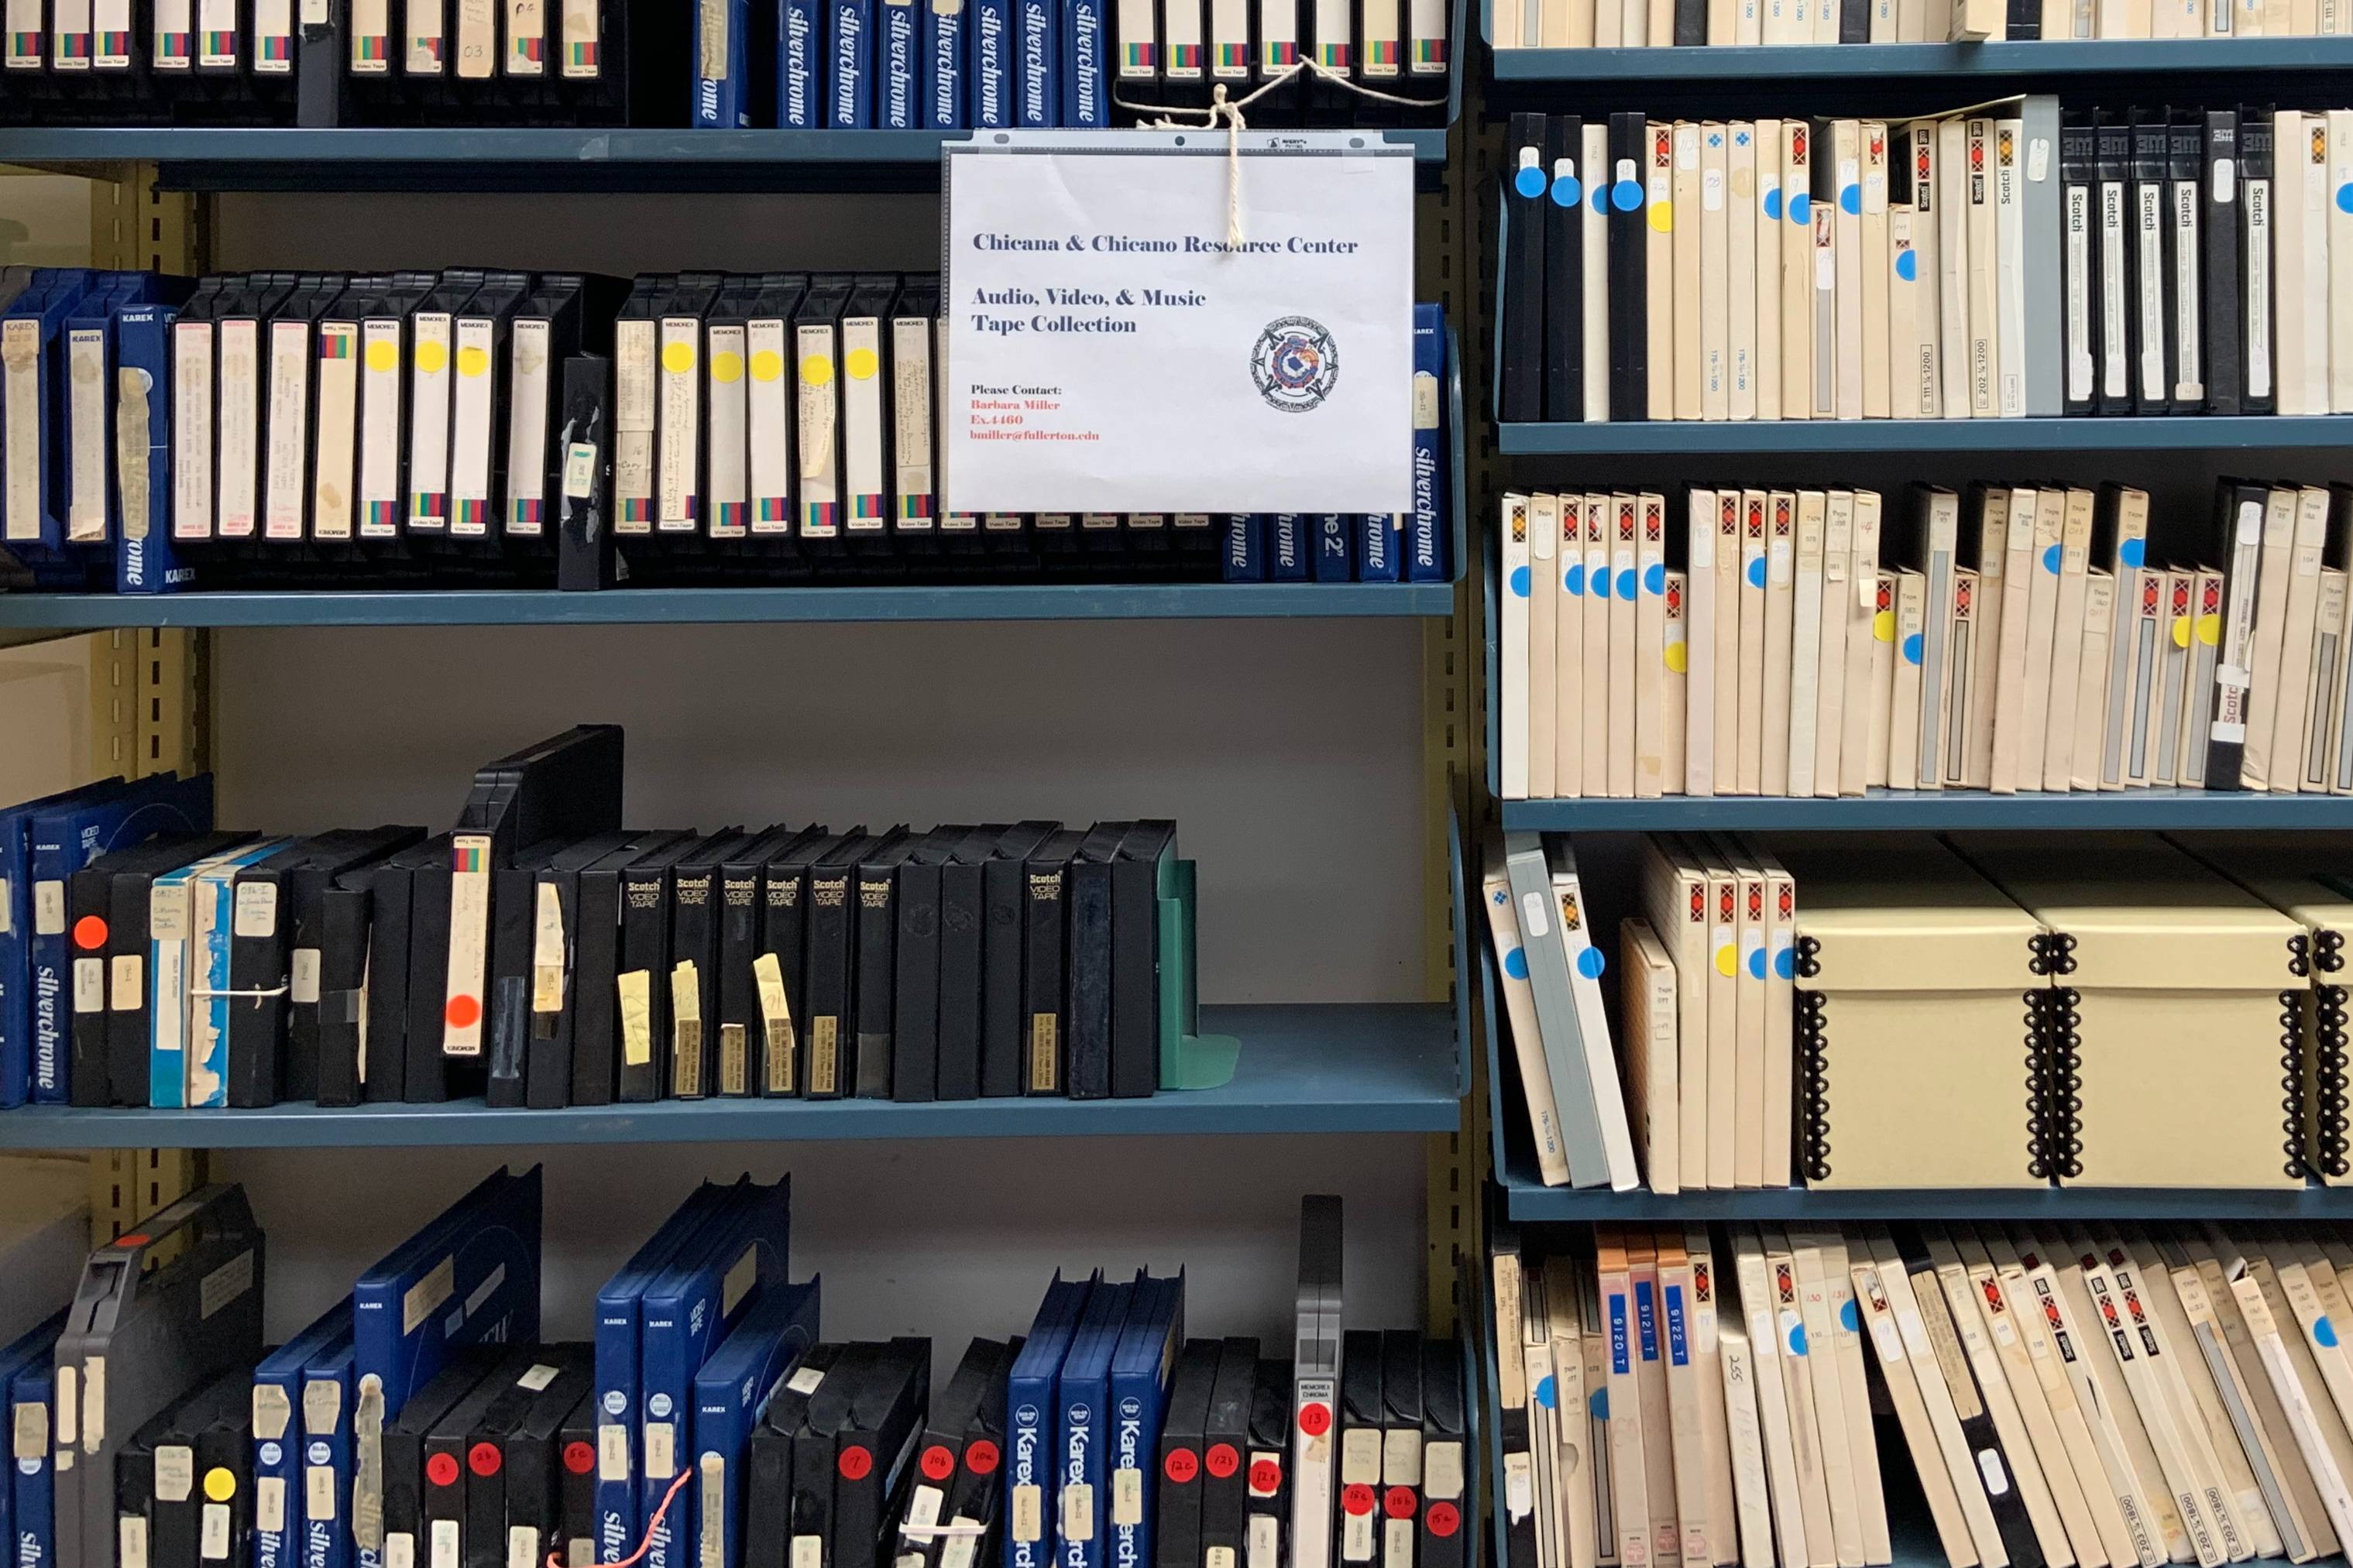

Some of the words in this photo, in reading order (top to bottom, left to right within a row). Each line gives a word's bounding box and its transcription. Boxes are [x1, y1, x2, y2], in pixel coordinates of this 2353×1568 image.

[788, 6, 809, 125] silverchrome
[838, 4, 860, 125] silverchrome
[890, 9, 911, 128] silverchrome
[981, 5, 1002, 125] silverchrome
[1026, 2, 1047, 122] silverchrome
[1076, 3, 1097, 123] silverchrome
[2001, 170, 2010, 204] Scotch
[2073, 194, 2083, 232] Scotch
[2107, 190, 2118, 228] Scotch
[2144, 192, 2155, 231] Scotch
[2181, 189, 2191, 227] Scotch
[2253, 187, 2264, 226] Scotch
[972, 234, 1060, 252] Chicana
[1066, 235, 1085, 252] &
[1091, 235, 1178, 253] Chicano
[1183, 236, 1281, 253] Resource
[1287, 236, 1359, 254] Center
[971, 288, 1039, 308] Audio,
[1045, 288, 1109, 307] Video,
[1115, 290, 1135, 307] &
[1142, 289, 1207, 307] Music
[6, 322, 36, 331] KAREX
[122, 314, 153, 322] KAREX
[971, 315, 1025, 337] Tape
[1030, 314, 1136, 334] Collection
[971, 384, 1008, 395] Please
[1012, 385, 1062, 395] Contact:
[971, 400, 1020, 410] Barbara
[1025, 400, 1060, 410] Miller
[970, 430, 1099, 442] bmiller@fullerton.edu
[1415, 447, 1436, 567] silverchrome
[166, 568, 196, 583] KAREX
[2224, 684, 2238, 723] Scotc
[628, 881, 660, 891] Scotch
[677, 878, 709, 888] Scotch
[724, 880, 754, 889] Scotch
[767, 879, 797, 889] Scotch
[813, 880, 845, 889] Scotch
[860, 881, 889, 890] Scotch
[1029, 874, 1061, 884] Scotch
[628, 893, 659, 901] VIDEO
[630, 900, 657, 908] TAPE
[816, 897, 841, 906] TAPE
[38, 966, 59, 1089] silverchrome
[1613, 1318, 1623, 1350] 9120
[1640, 1306, 1651, 1335] 9121
[1671, 1309, 1682, 1340] 9122
[1017, 1428, 1037, 1486] Karex
[1069, 1427, 1089, 1485] Karex
[1120, 1421, 1140, 1469] Kare
